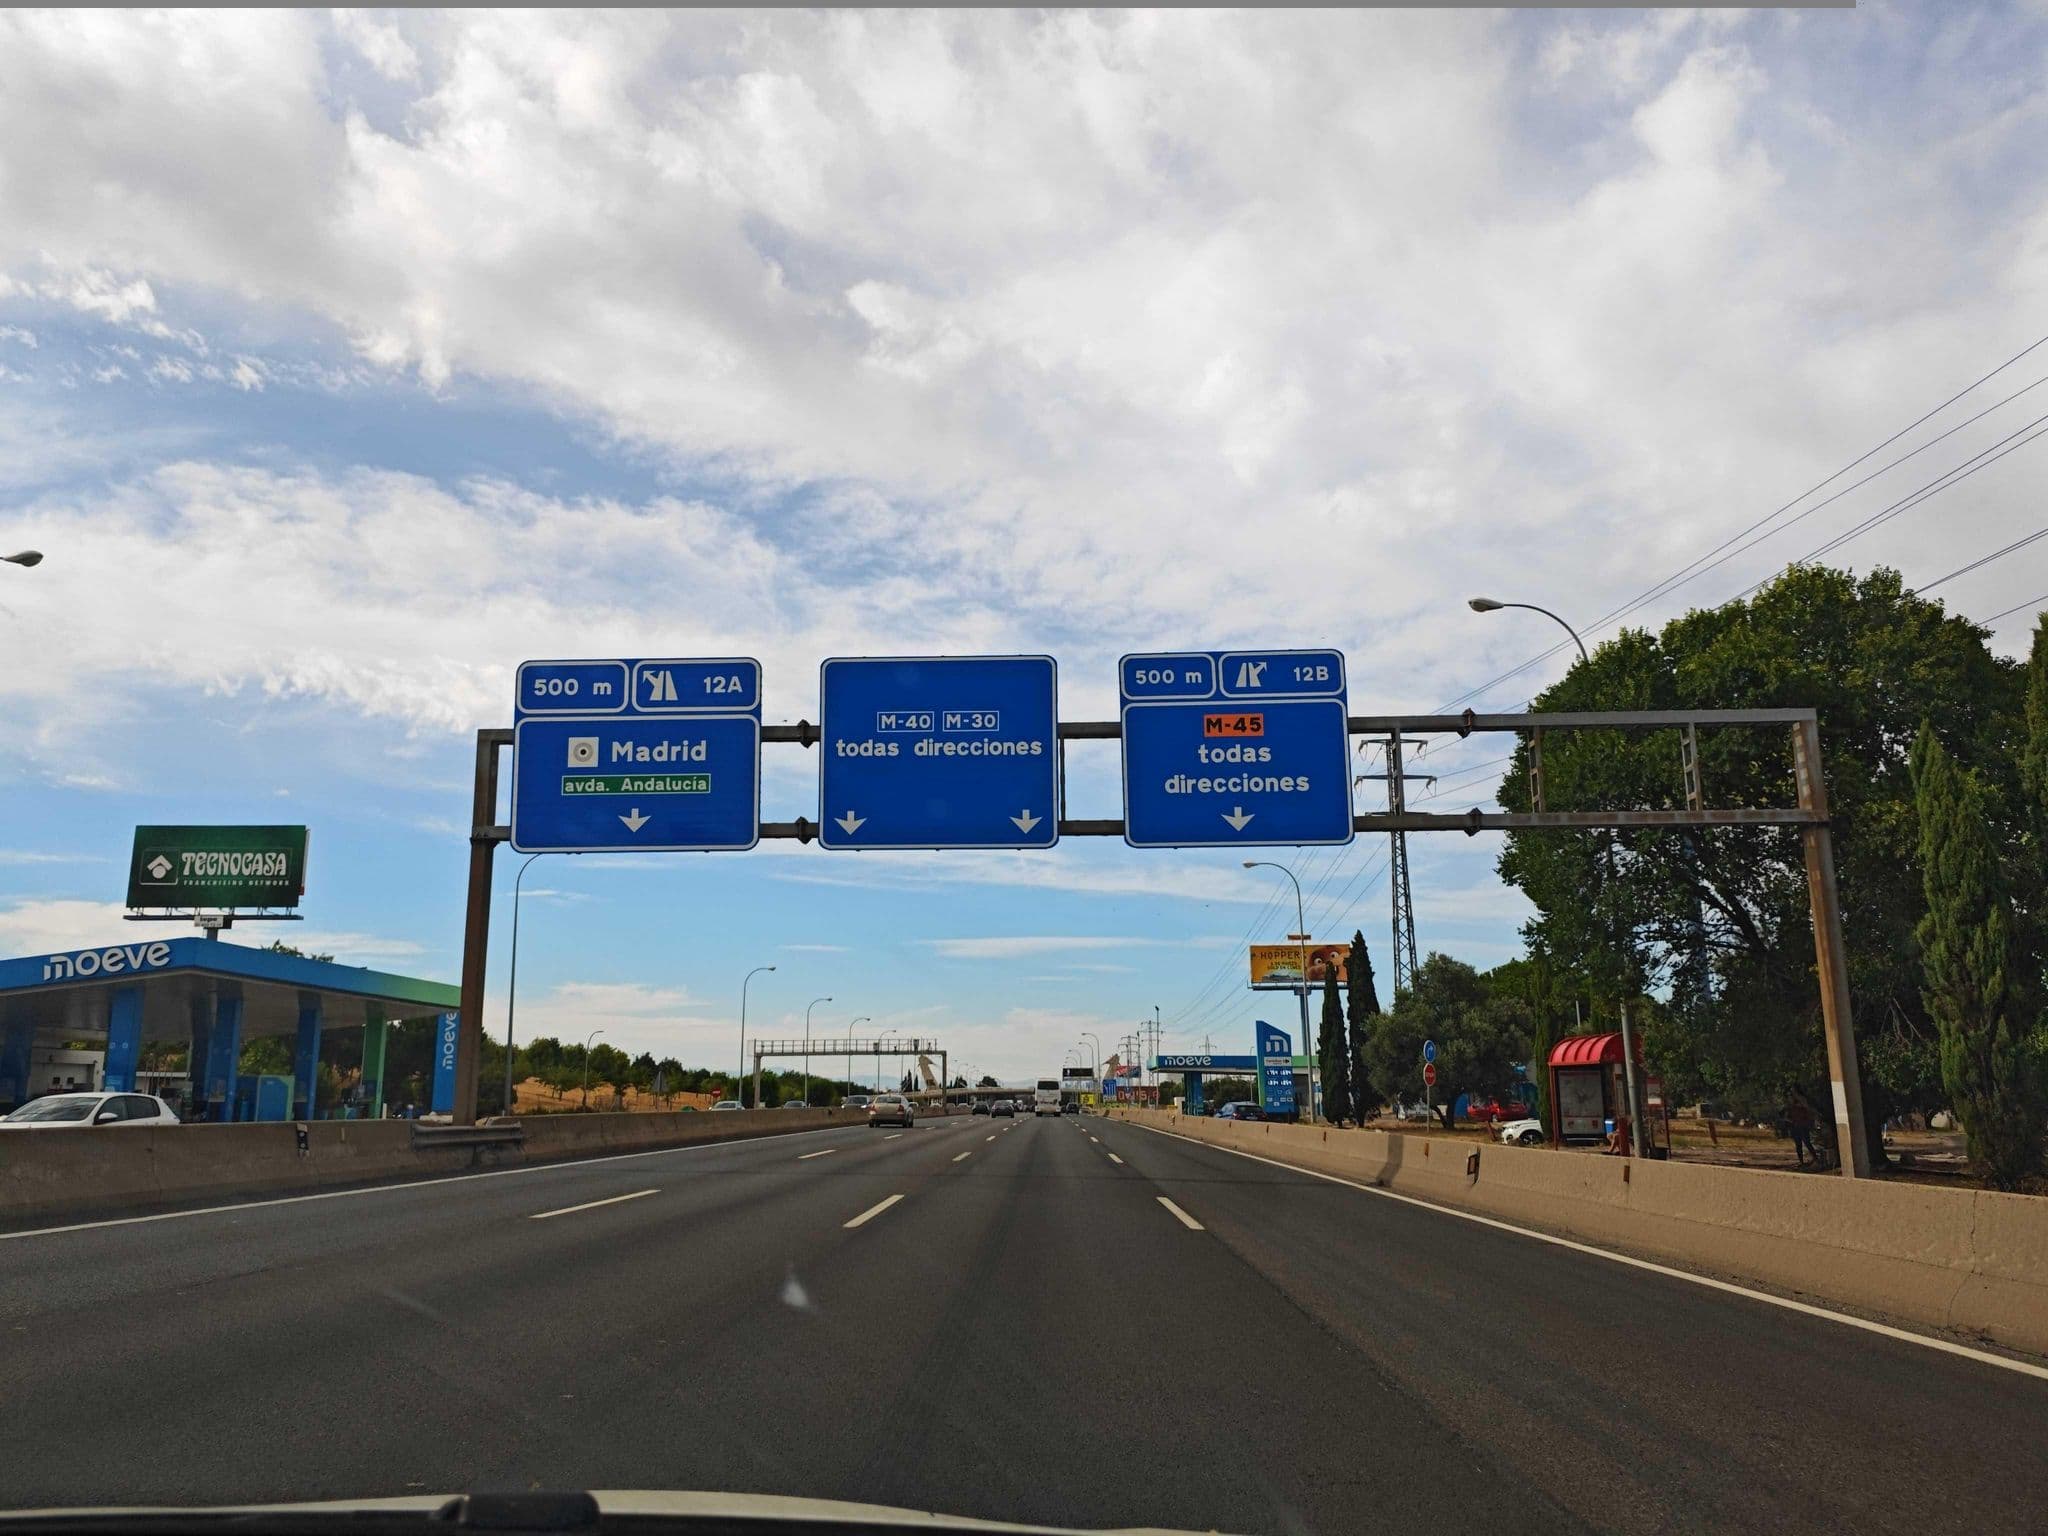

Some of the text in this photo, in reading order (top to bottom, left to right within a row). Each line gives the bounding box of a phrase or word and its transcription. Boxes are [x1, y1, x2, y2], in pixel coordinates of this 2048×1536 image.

[1135, 669, 1202, 685] 500 m
[1293, 665, 1329, 682] 12B
[534, 678, 612, 696] 500 m
[704, 676, 743, 694] 12A
[880, 713, 996, 729] M-40 M-30
[1206, 717, 1262, 734] M-45
[611, 740, 707, 763] Madrid
[836, 737, 1043, 757] todas direcciones
[1198, 744, 1271, 763] todas
[564, 776, 707, 793] avda. Andalucía
[1164, 773, 1310, 794] direcciones
[181, 851, 287, 877] TECNOCASA
[43, 942, 170, 981] moeve
[441, 1011, 458, 1071] moeve
[1164, 1056, 1212, 1067] moeve
